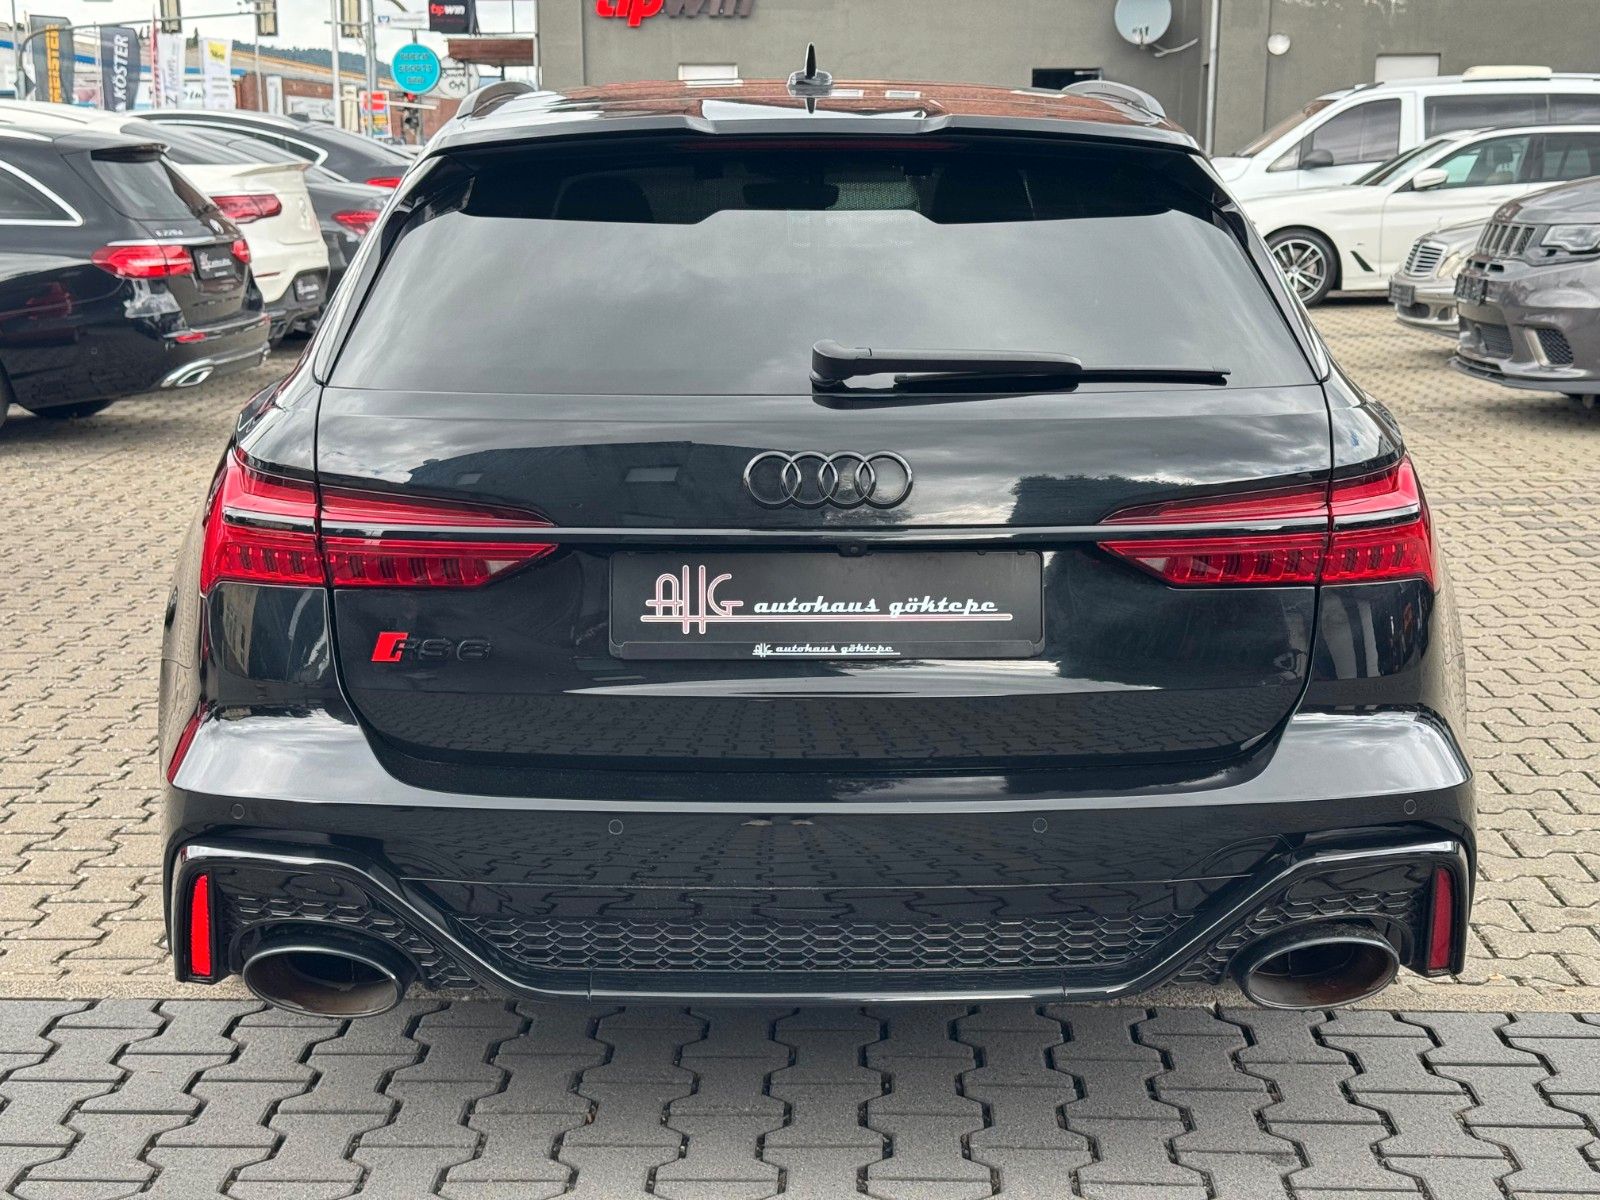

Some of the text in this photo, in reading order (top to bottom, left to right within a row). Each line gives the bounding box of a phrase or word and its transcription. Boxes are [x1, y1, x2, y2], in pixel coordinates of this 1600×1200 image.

[112, 34, 129, 99] KÖSTER
[754, 596, 880, 613] autohaus
[889, 596, 998, 617] göktepe
[372, 631, 493, 662] RS6
[775, 643, 837, 652] autohaus
[840, 643, 894, 654] göktepe
